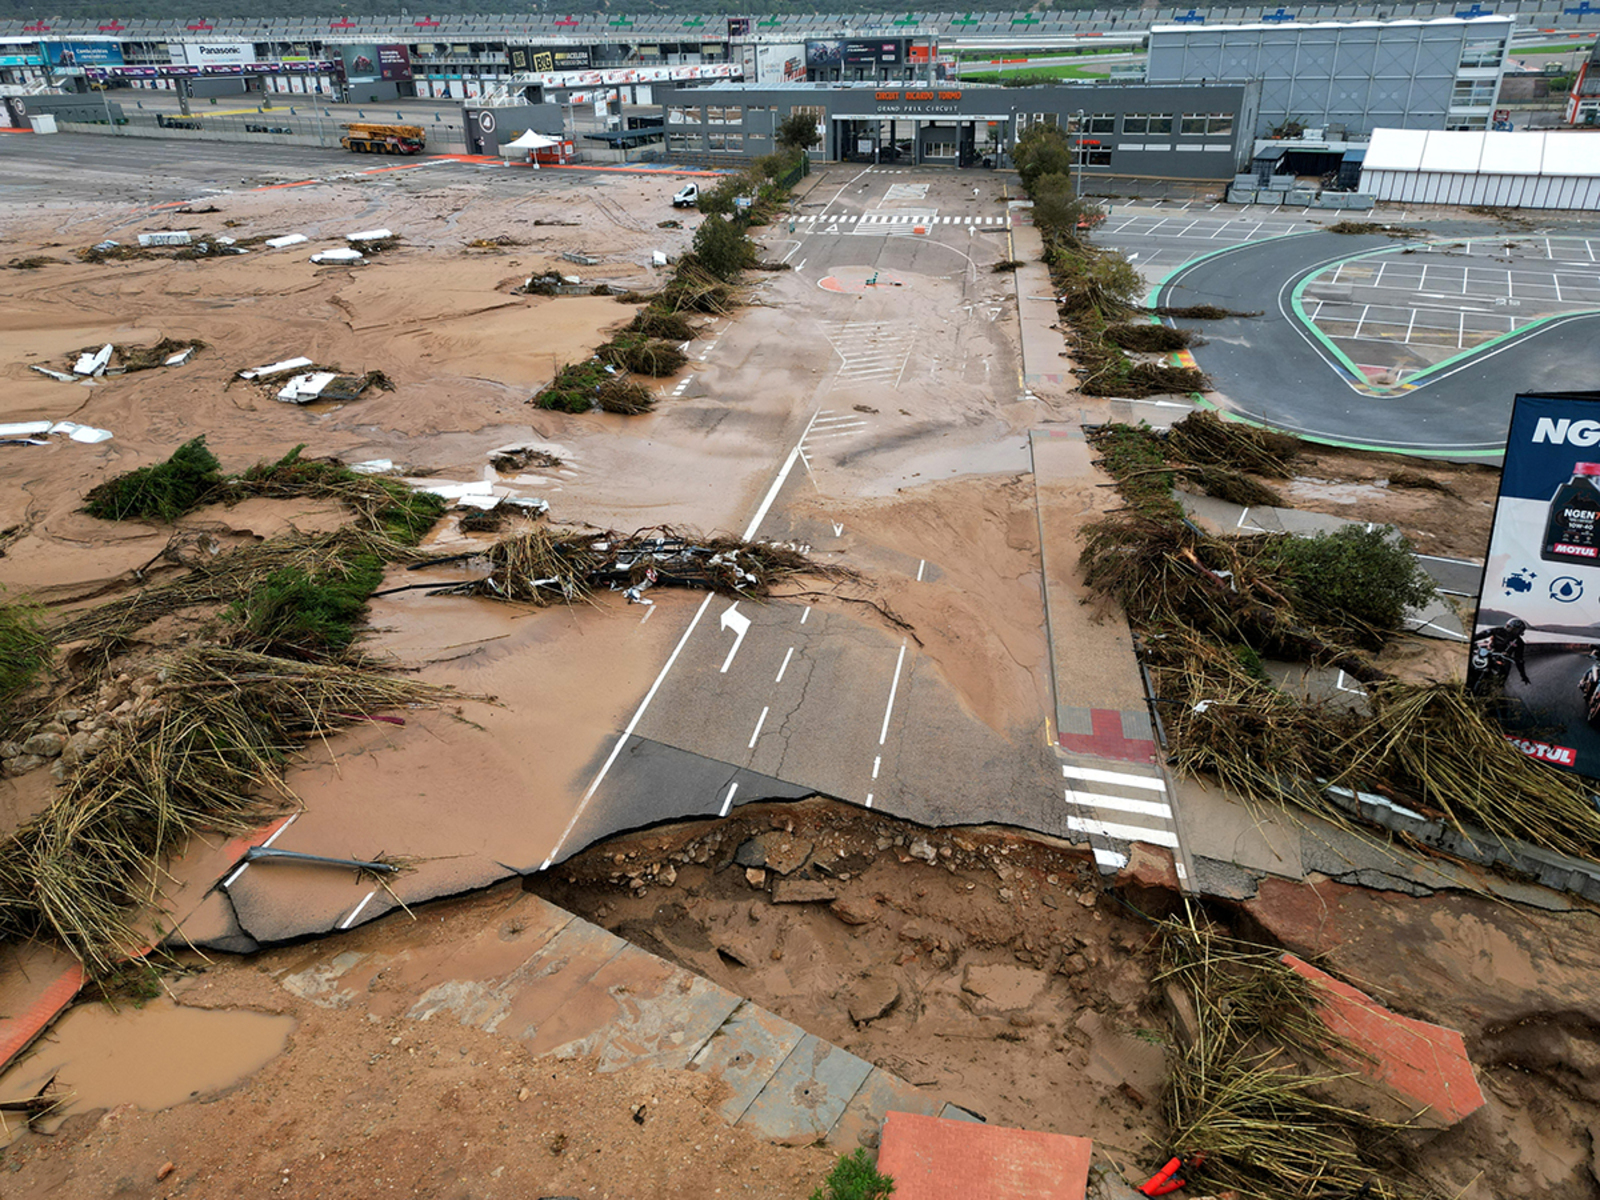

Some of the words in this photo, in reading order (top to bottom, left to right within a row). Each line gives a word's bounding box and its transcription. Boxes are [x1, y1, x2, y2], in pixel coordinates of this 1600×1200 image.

[199, 45, 241, 55] Panasonic
[875, 92, 899, 100] CIRCUIT
[905, 92, 934, 100] RICARDO
[938, 92, 962, 100] TORMO
[483, 116, 491, 127] 4
[1532, 417, 1600, 448] NG
[1568, 522, 1594, 530] 10W-40
[1554, 544, 1596, 556] MOTUL
